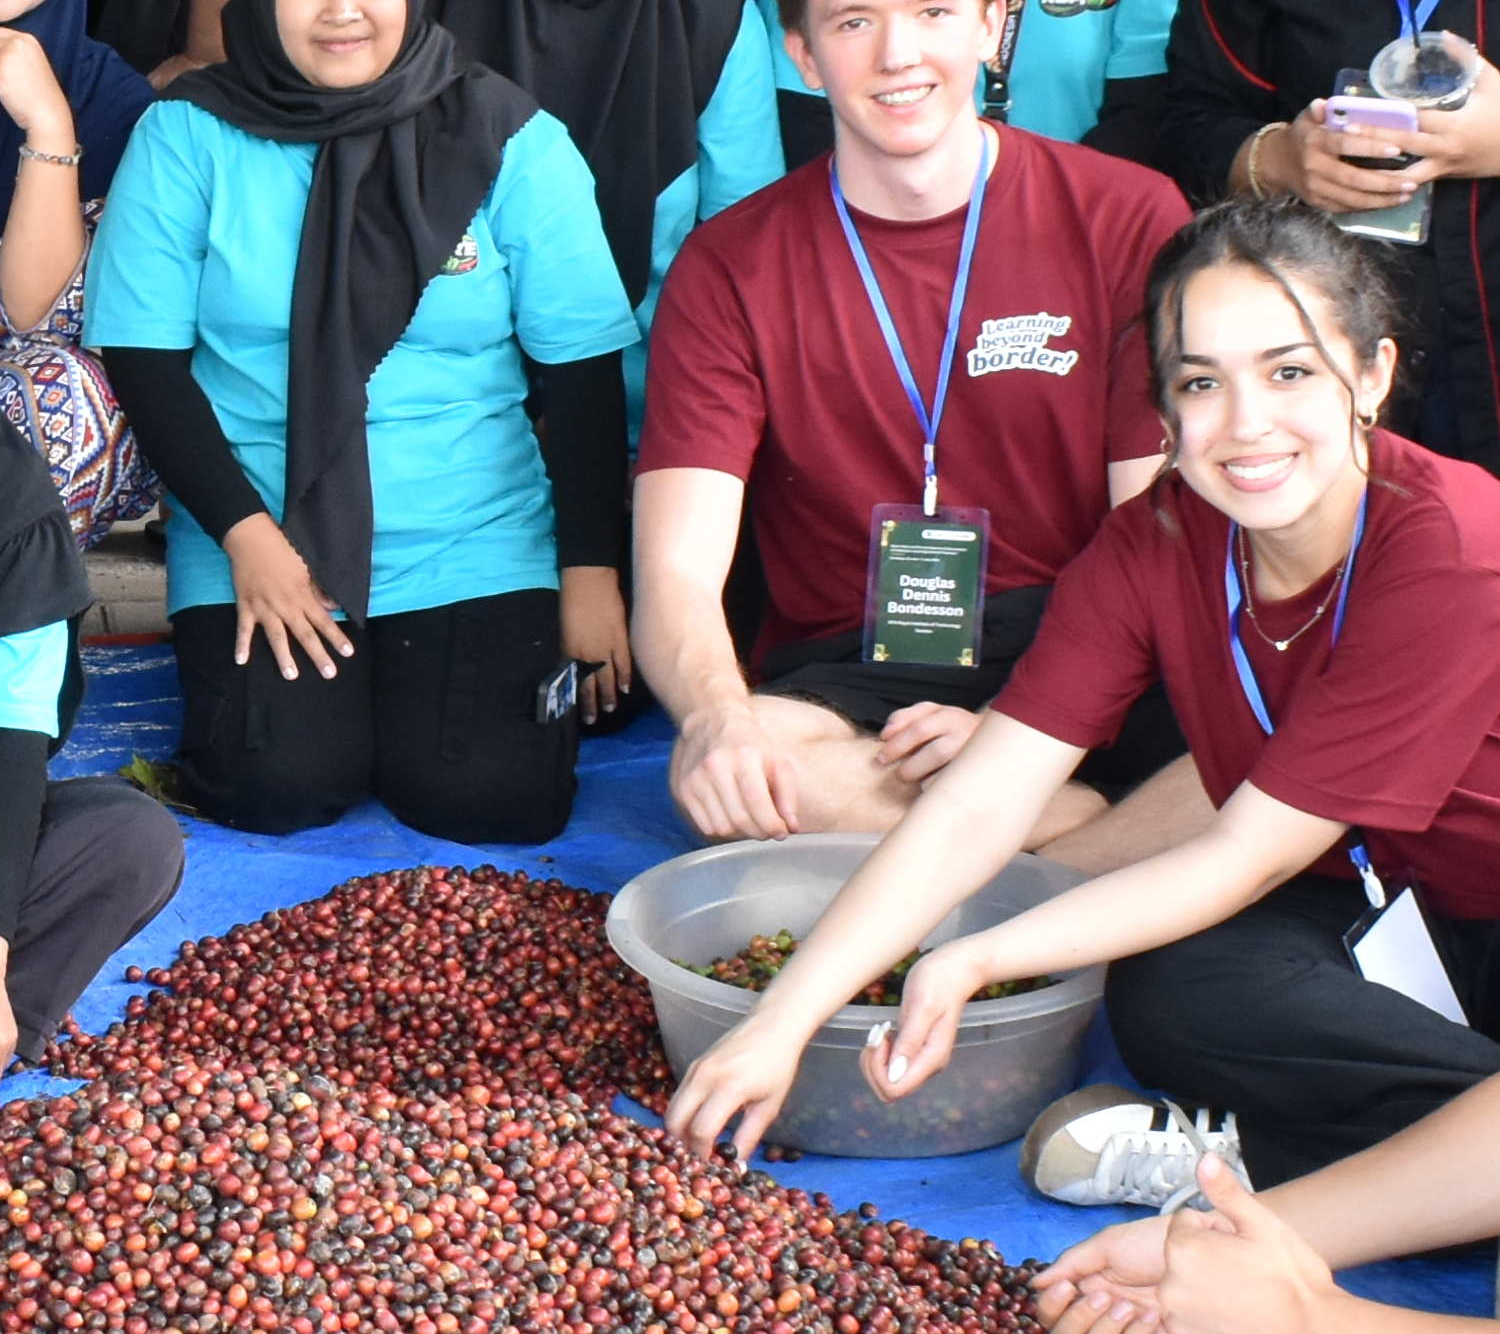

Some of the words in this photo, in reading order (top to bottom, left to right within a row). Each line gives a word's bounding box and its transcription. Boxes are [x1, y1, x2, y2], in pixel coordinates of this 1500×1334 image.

[986, 315, 1068, 335] Learning
[981, 331, 1046, 350] beyond
[973, 347, 1074, 372] border!
[899, 574, 956, 591] Douglas
[902, 588, 951, 603] Dennis
[887, 601, 964, 617] Bondesson
